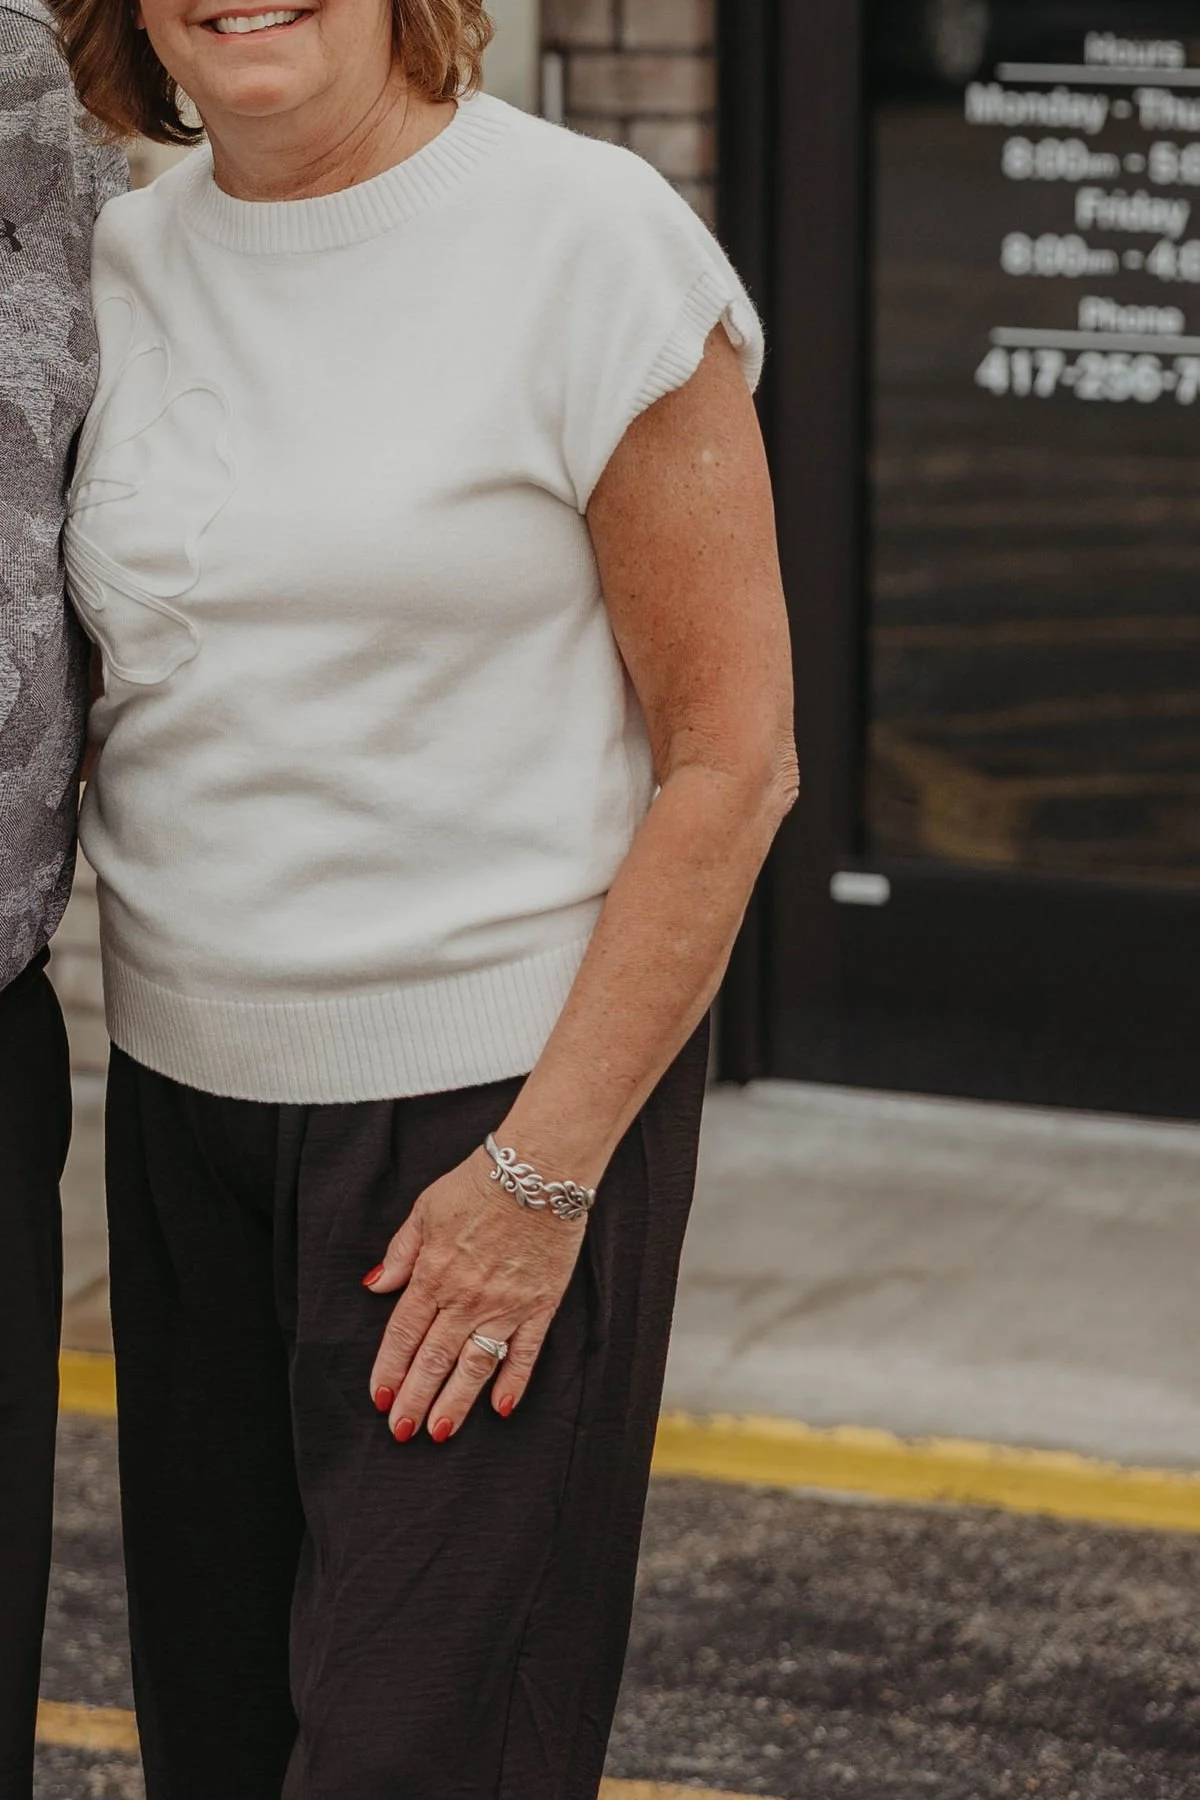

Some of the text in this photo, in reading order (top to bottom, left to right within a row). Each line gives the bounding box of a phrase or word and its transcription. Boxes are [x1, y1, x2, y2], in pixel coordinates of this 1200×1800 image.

[1084, 31, 1185, 69] Hours
[965, 81, 1108, 135] Monday
[1075, 186, 1190, 240] Friday
[1078, 295, 1185, 335] Phone
